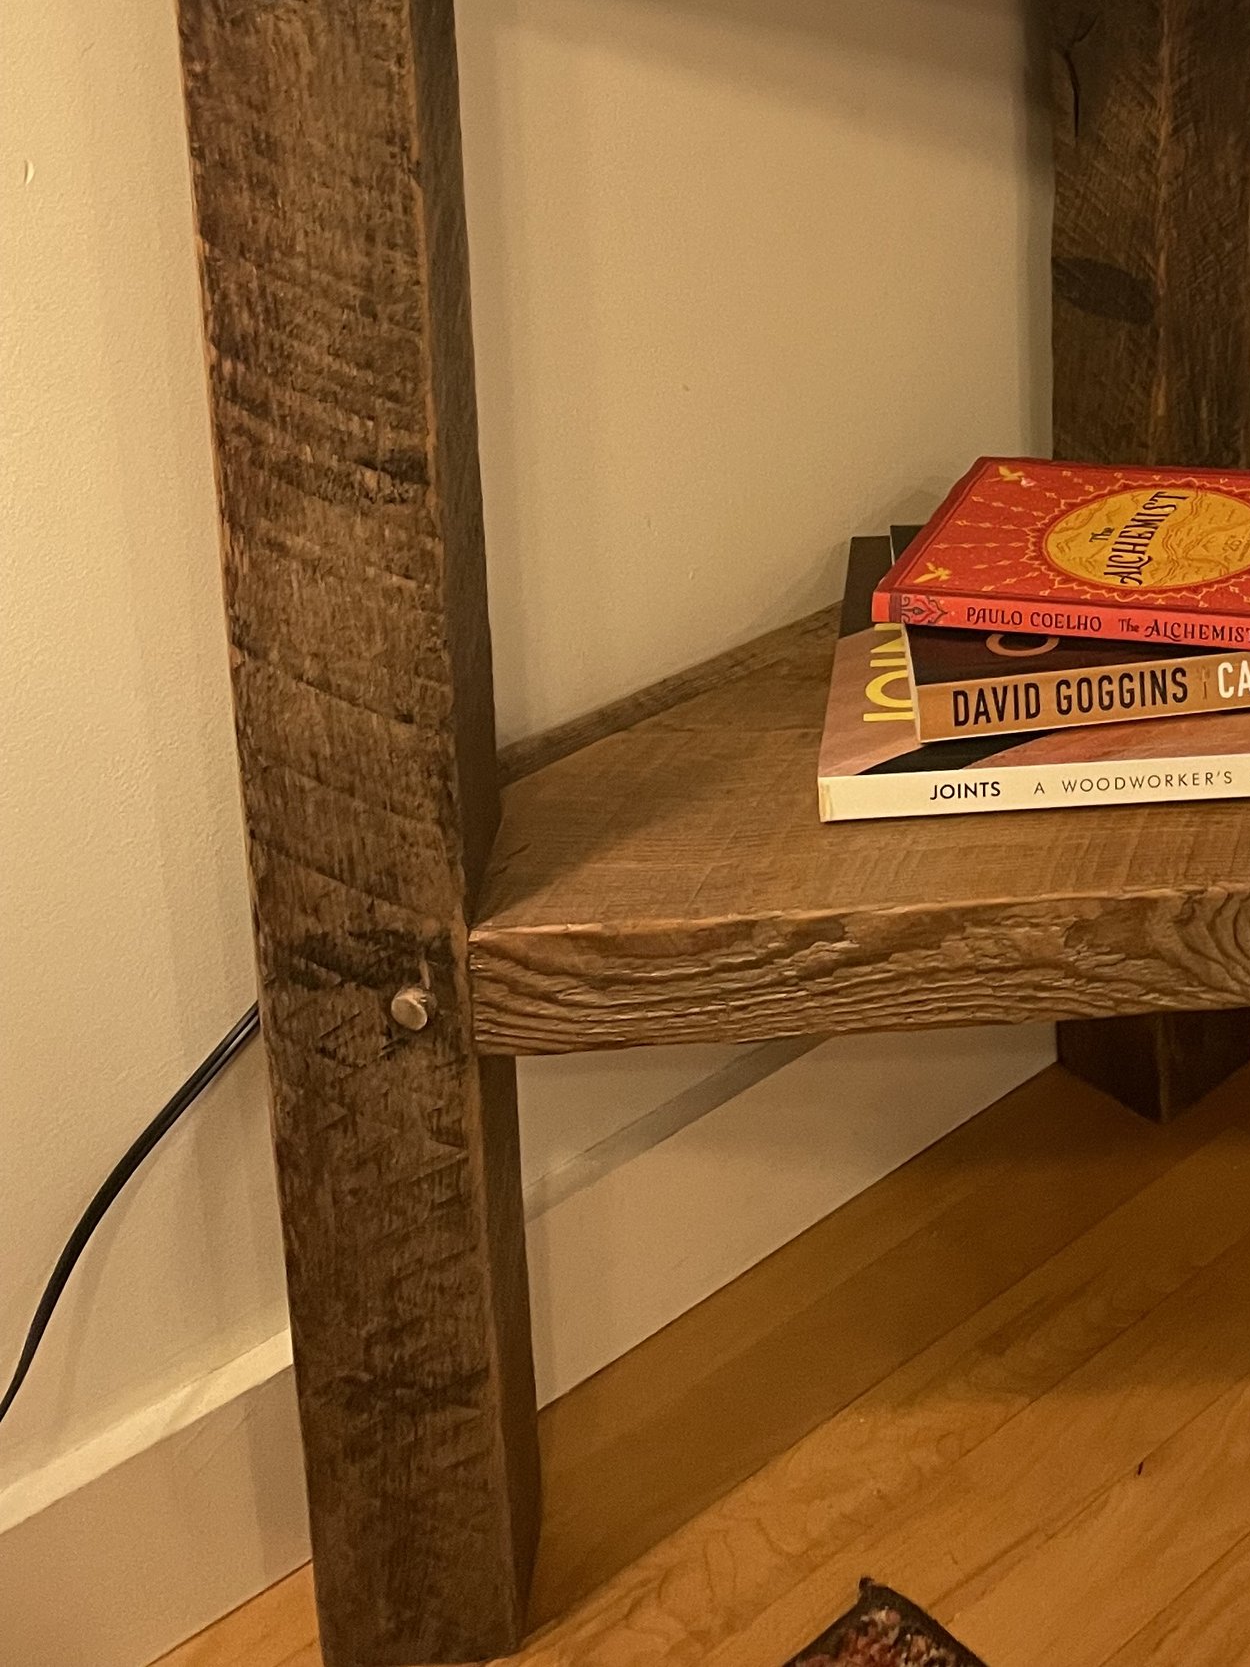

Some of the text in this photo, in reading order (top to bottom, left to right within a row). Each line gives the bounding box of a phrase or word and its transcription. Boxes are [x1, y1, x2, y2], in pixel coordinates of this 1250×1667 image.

[1089, 527, 1115, 542] The
[1103, 491, 1189, 585] ALCHEMIST
[966, 606, 1102, 632] PAULO COELHO
[1118, 618, 1140, 633] The
[952, 667, 1188, 727] DAVID GOGGINS
[930, 781, 1001, 800] JOINTS
[1034, 782, 1046, 795] A
[1062, 771, 1233, 793] WOODWORKER'S
